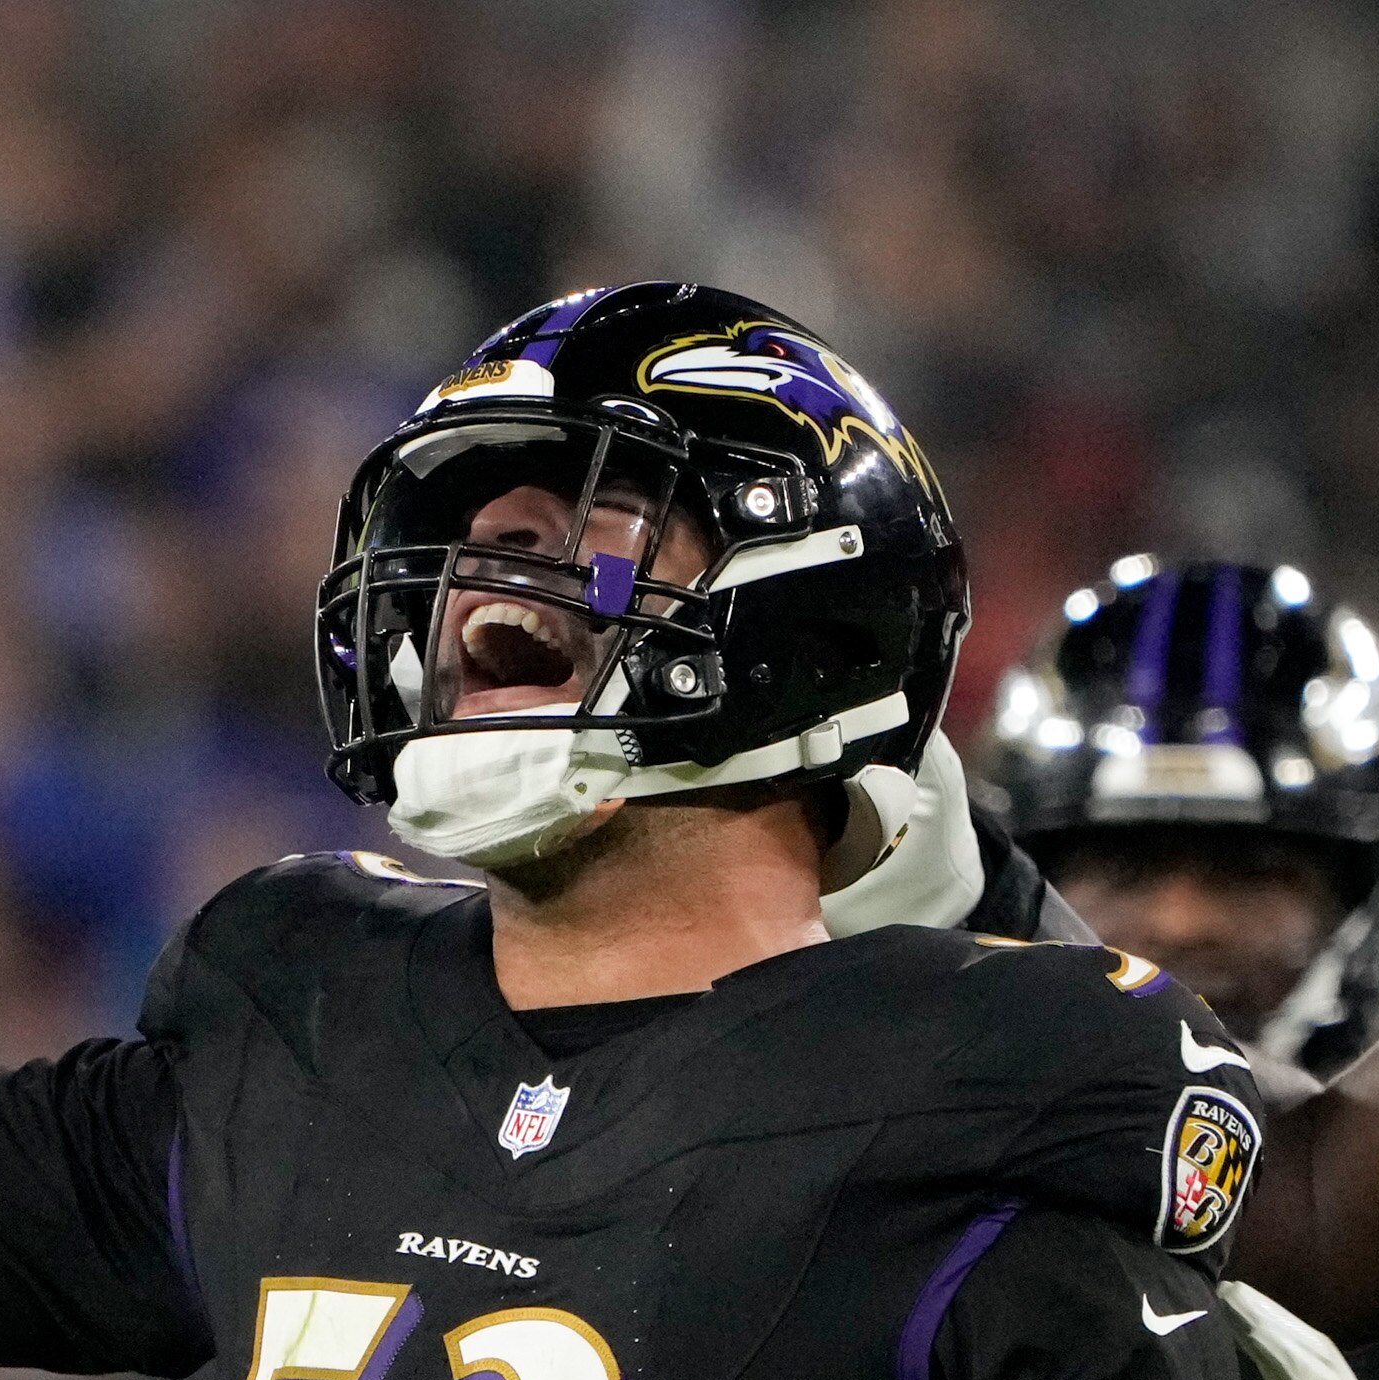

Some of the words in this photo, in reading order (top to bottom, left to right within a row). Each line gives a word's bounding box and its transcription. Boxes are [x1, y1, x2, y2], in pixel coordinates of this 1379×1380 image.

[438, 360, 515, 398] RAVENS
[508, 1112, 547, 1144] NFL
[1184, 1123, 1226, 1169] B
[1192, 1101, 1252, 1151] RAVENS
[396, 1232, 541, 1279] RAVENS
